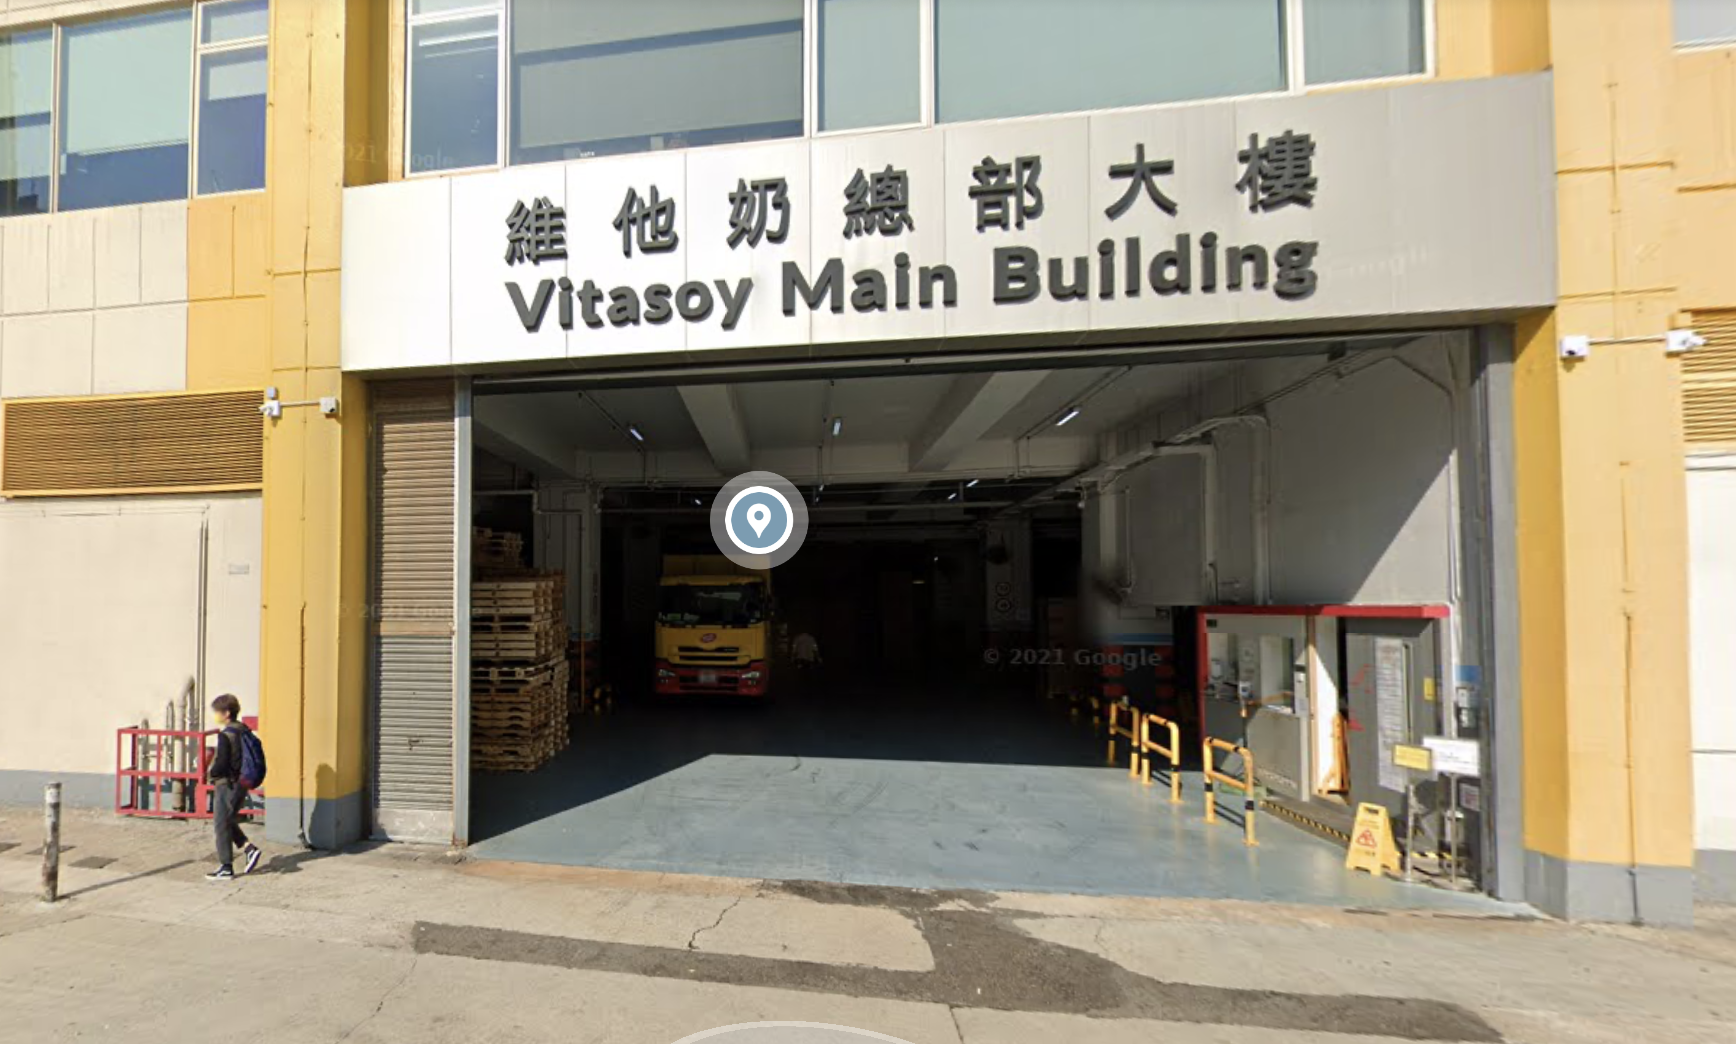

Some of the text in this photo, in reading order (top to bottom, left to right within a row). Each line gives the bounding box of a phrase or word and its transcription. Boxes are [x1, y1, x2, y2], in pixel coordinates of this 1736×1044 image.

[504, 130, 1318, 266] 維他奶總部大樓
[504, 276, 754, 333] Vitasoy
[782, 251, 957, 317] Main
[993, 231, 1319, 305] Building
